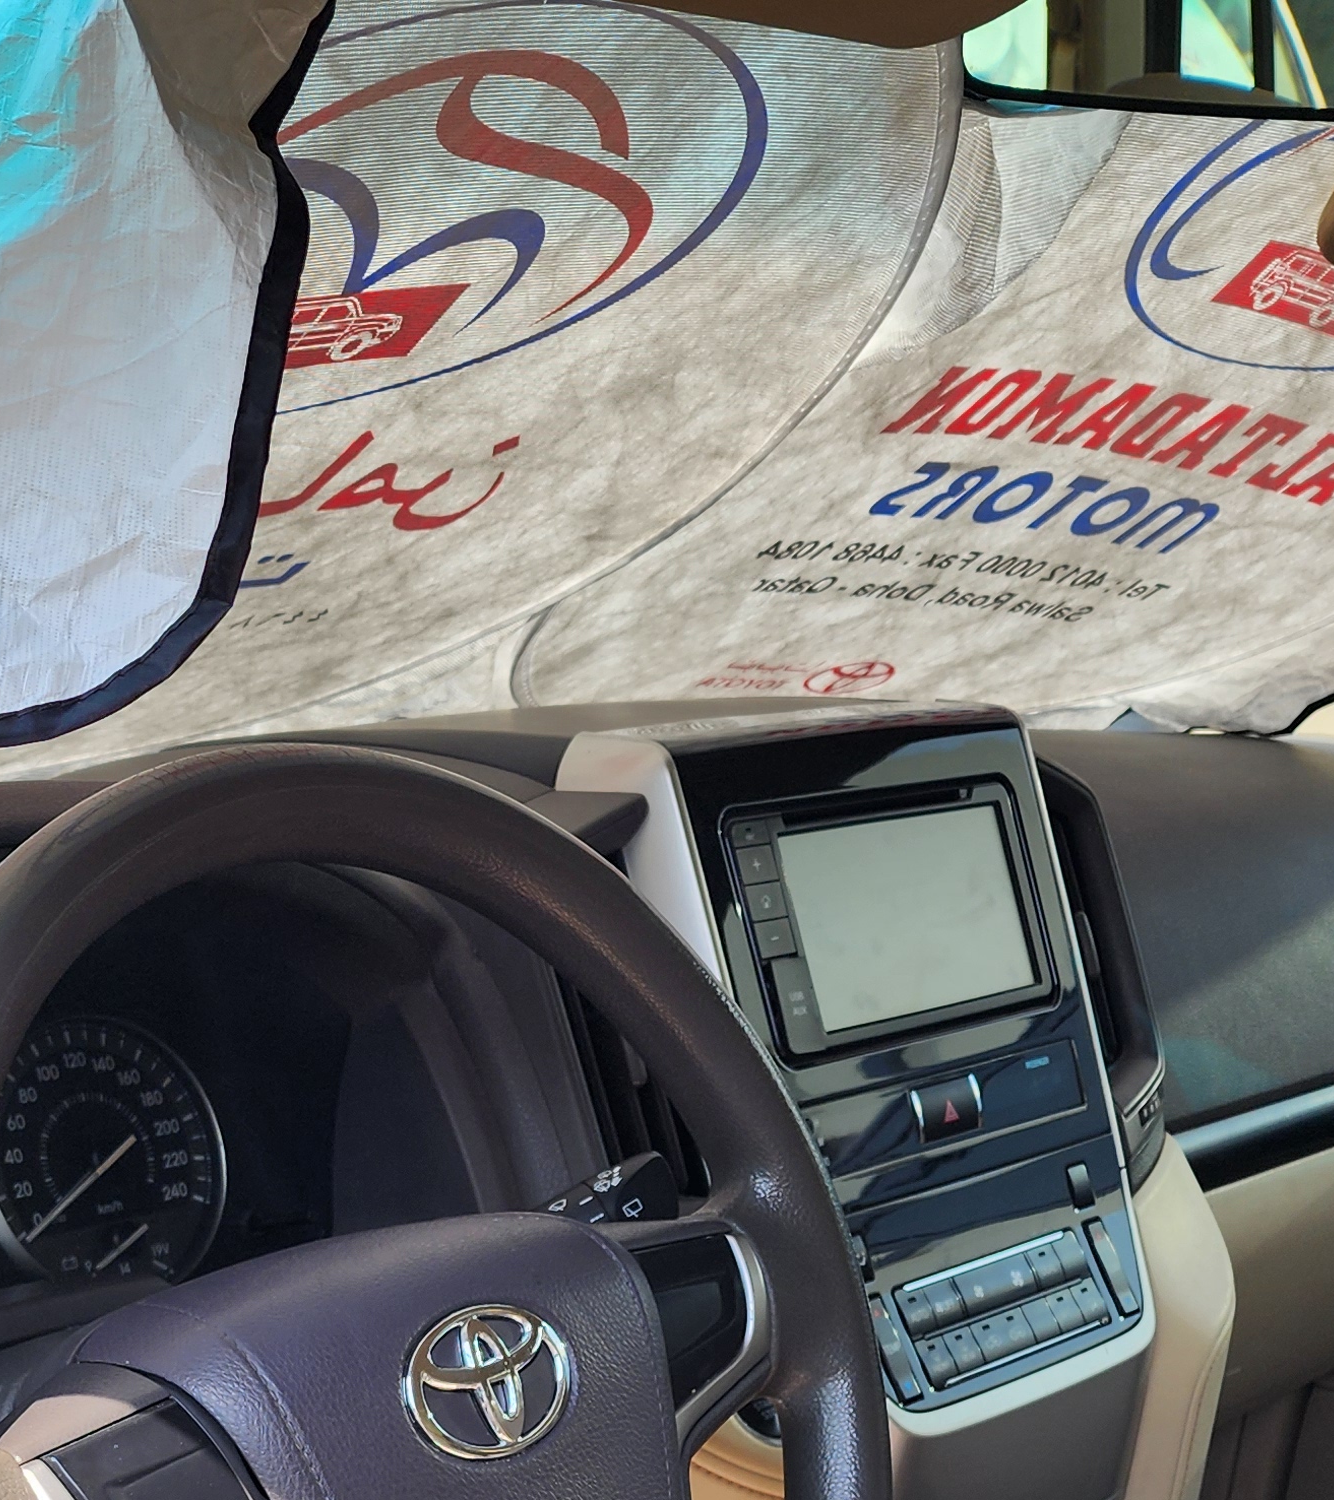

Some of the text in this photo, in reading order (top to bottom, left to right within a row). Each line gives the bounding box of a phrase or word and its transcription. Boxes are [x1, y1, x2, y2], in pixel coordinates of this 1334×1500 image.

[63, 1051, 87, 1068] 120
[36, 1064, 60, 1082] 100
[18, 1087, 38, 1104] 80
[7, 1114, 26, 1131] 60
[153, 1119, 181, 1137] 200
[4, 1148, 24, 1165] 40
[162, 1151, 188, 1169] 220
[14, 1180, 33, 1199] 20
[162, 1182, 188, 1201] 240
